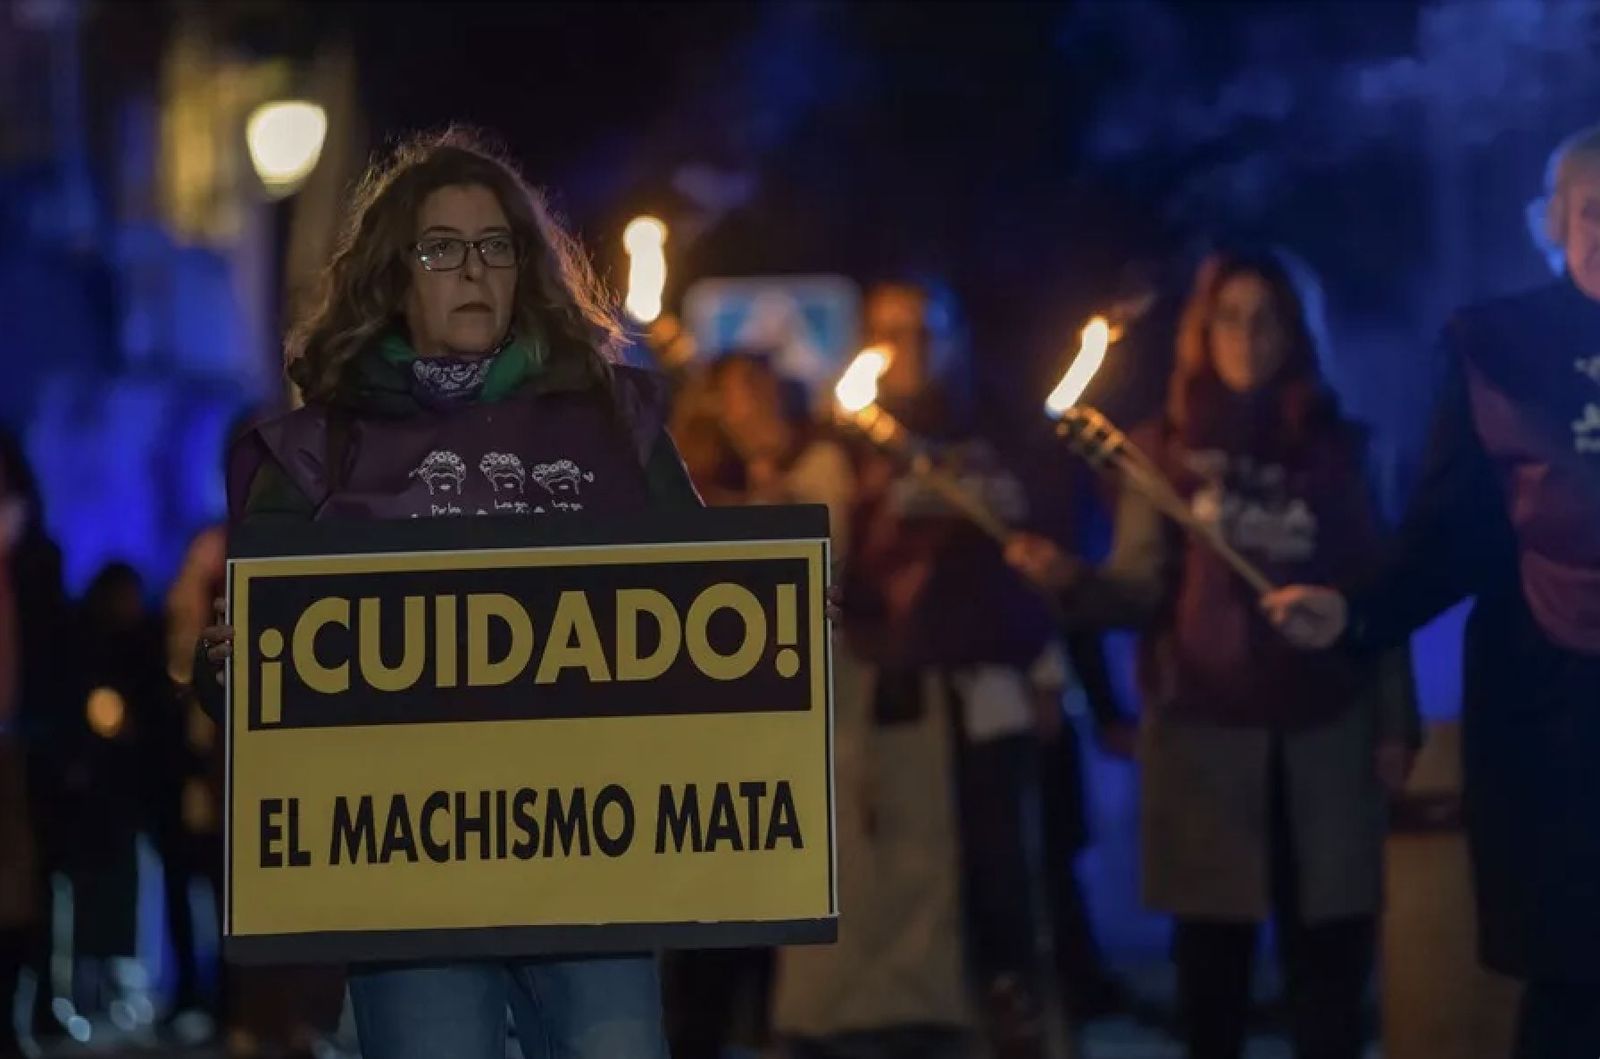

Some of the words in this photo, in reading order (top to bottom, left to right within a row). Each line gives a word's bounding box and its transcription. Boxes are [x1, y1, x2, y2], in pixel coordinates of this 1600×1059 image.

[258, 583, 800, 724] ¡CUIDADO!
[259, 797, 311, 868] EL
[329, 783, 636, 865] MACHISMO
[654, 780, 804, 854] MATA
